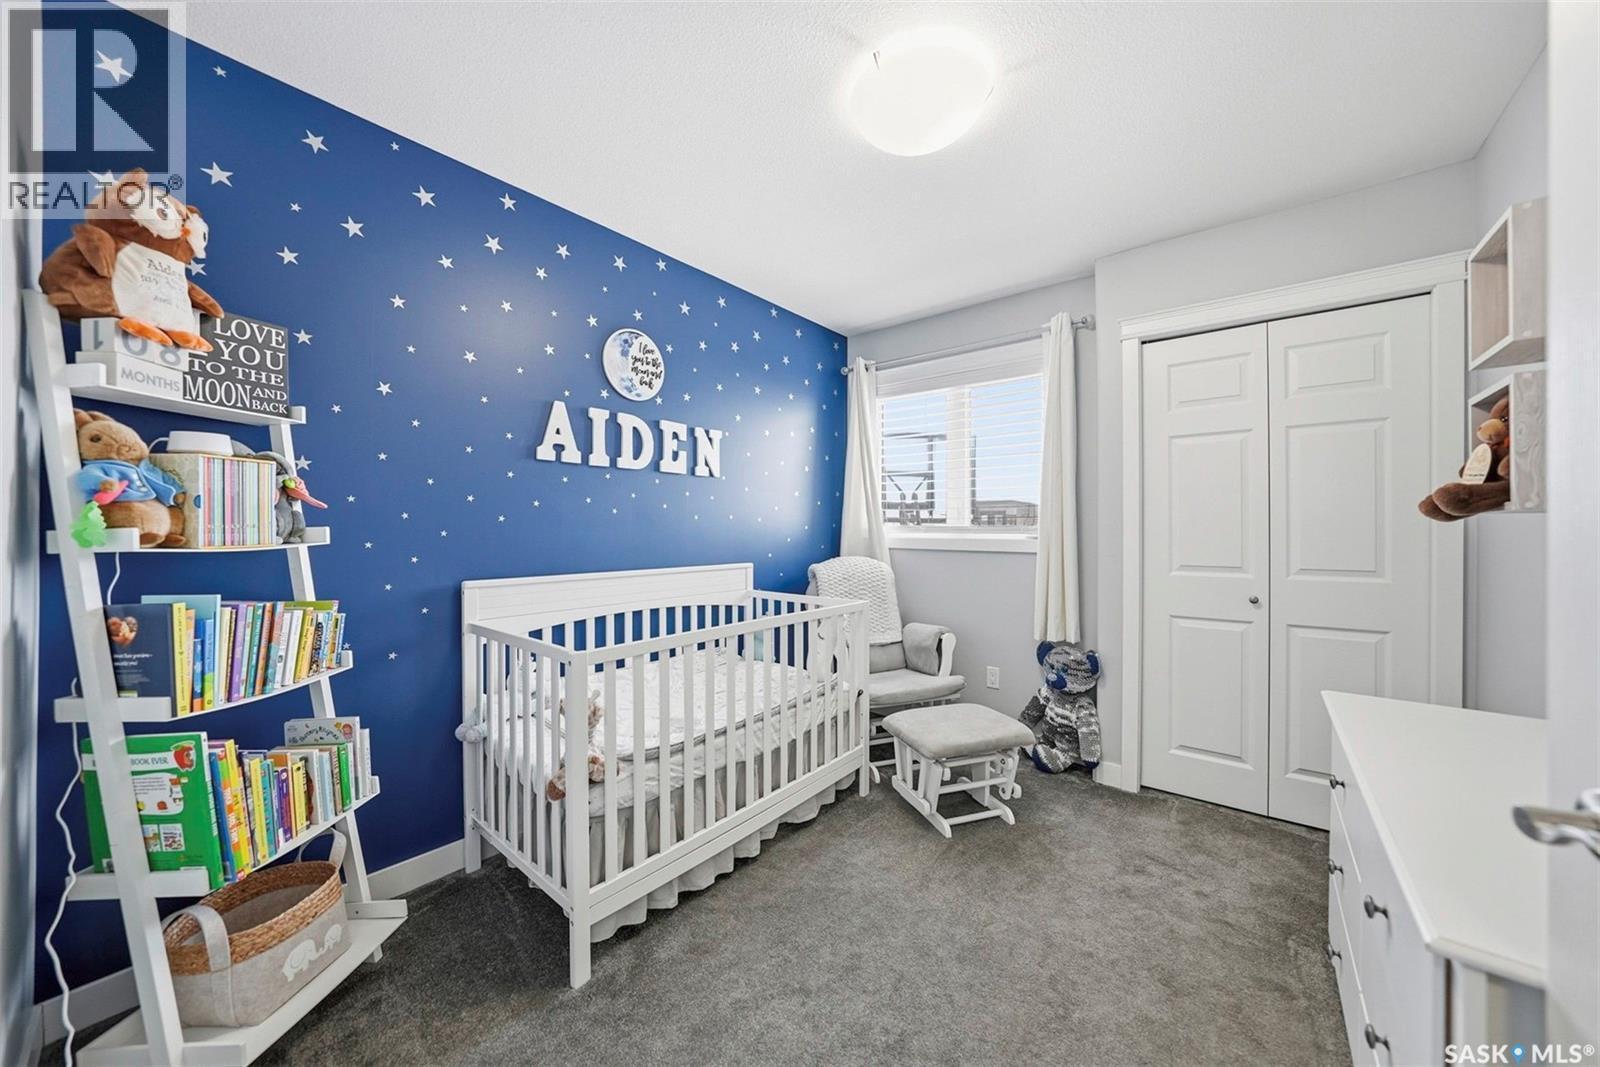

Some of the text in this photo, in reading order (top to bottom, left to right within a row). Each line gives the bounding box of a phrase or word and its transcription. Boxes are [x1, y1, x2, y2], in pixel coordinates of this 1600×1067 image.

[214, 319, 286, 349] LOVE
[214, 338, 287, 371] YOU
[121, 367, 180, 392] MONTHS
[188, 359, 284, 387] TO THE
[184, 375, 287, 408] MOON AND
[252, 400, 288, 414] BACK
[536, 400, 723, 478] AIDEN
[130, 757, 169, 766] BOOK EVER
